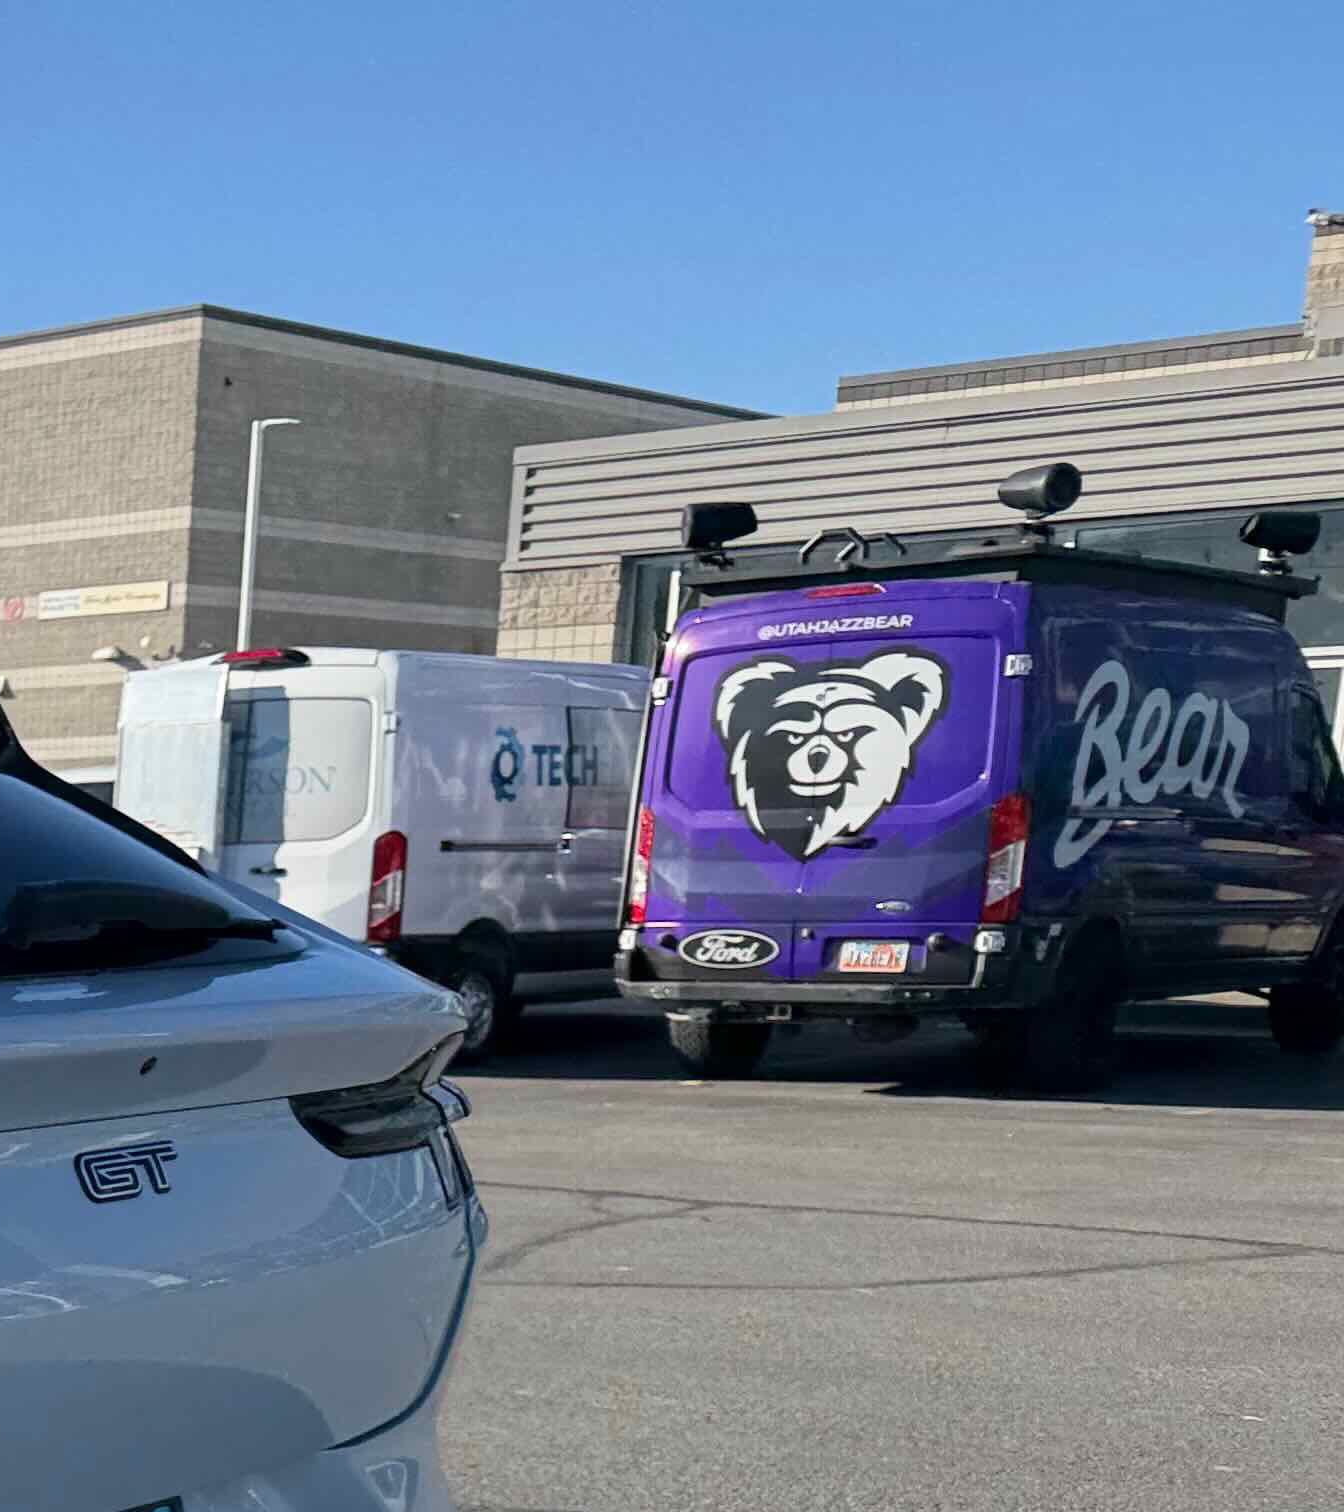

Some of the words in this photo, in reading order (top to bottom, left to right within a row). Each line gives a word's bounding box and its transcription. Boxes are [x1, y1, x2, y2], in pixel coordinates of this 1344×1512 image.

[758, 614, 914, 641] @UTAHJAZZBEAR
[531, 744, 599, 787] TECH
[1054, 660, 1250, 869] Bear
[73, 1139, 179, 1204] GT
